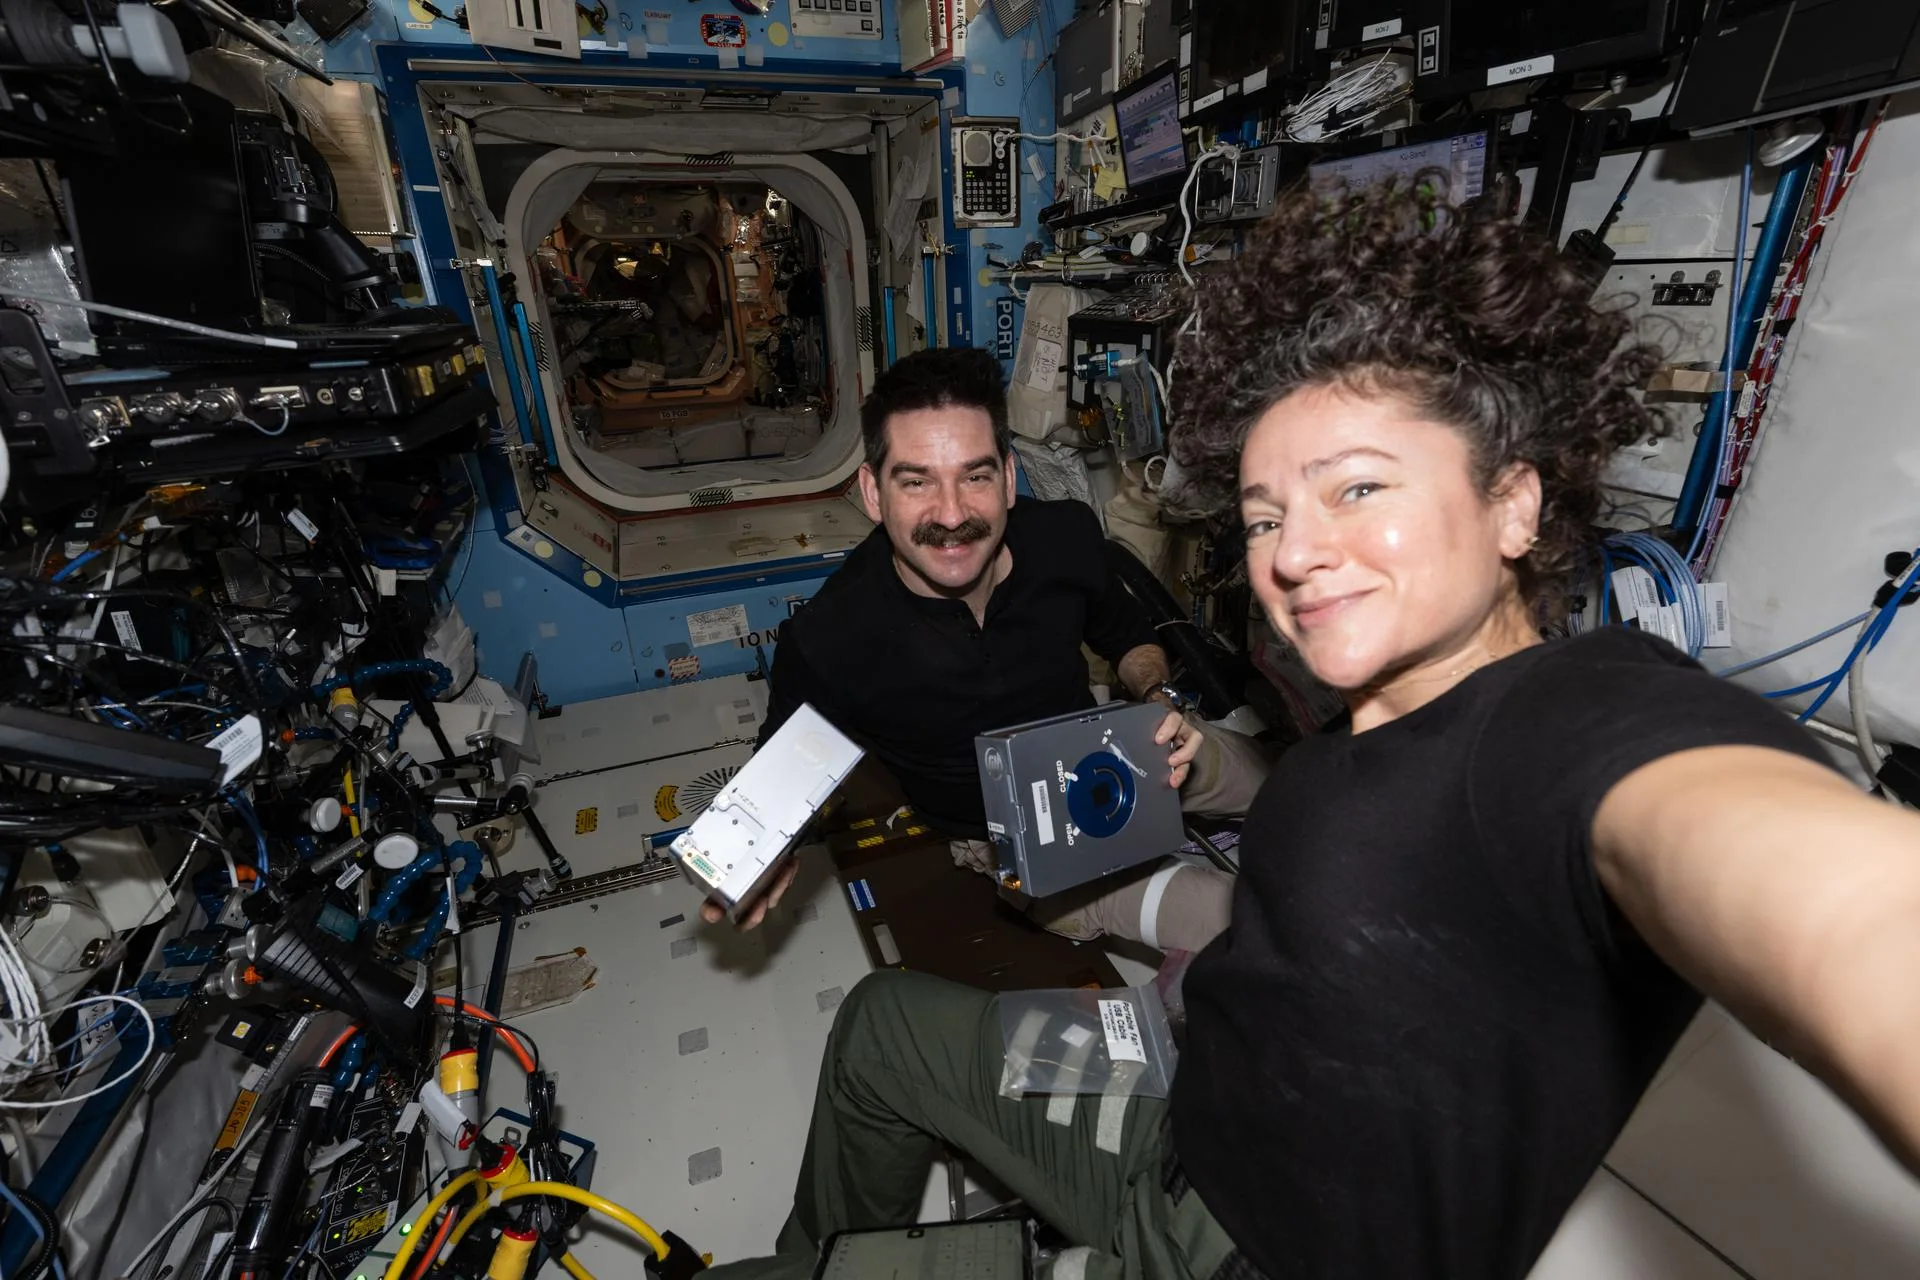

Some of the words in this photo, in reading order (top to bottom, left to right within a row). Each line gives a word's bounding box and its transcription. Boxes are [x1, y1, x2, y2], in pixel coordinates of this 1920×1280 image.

[1509, 66, 1526, 76] MON
[1527, 64, 1533, 72] 3
[997, 300, 1013, 358] PORT
[1055, 759, 1067, 793] CLOSED
[1065, 822, 1076, 846] OPEN
[1112, 1003, 1123, 1018] USB
[1117, 1019, 1128, 1041] Cable
[1122, 1001, 1135, 1031] Portable
[1129, 1032, 1139, 1046] Fan
